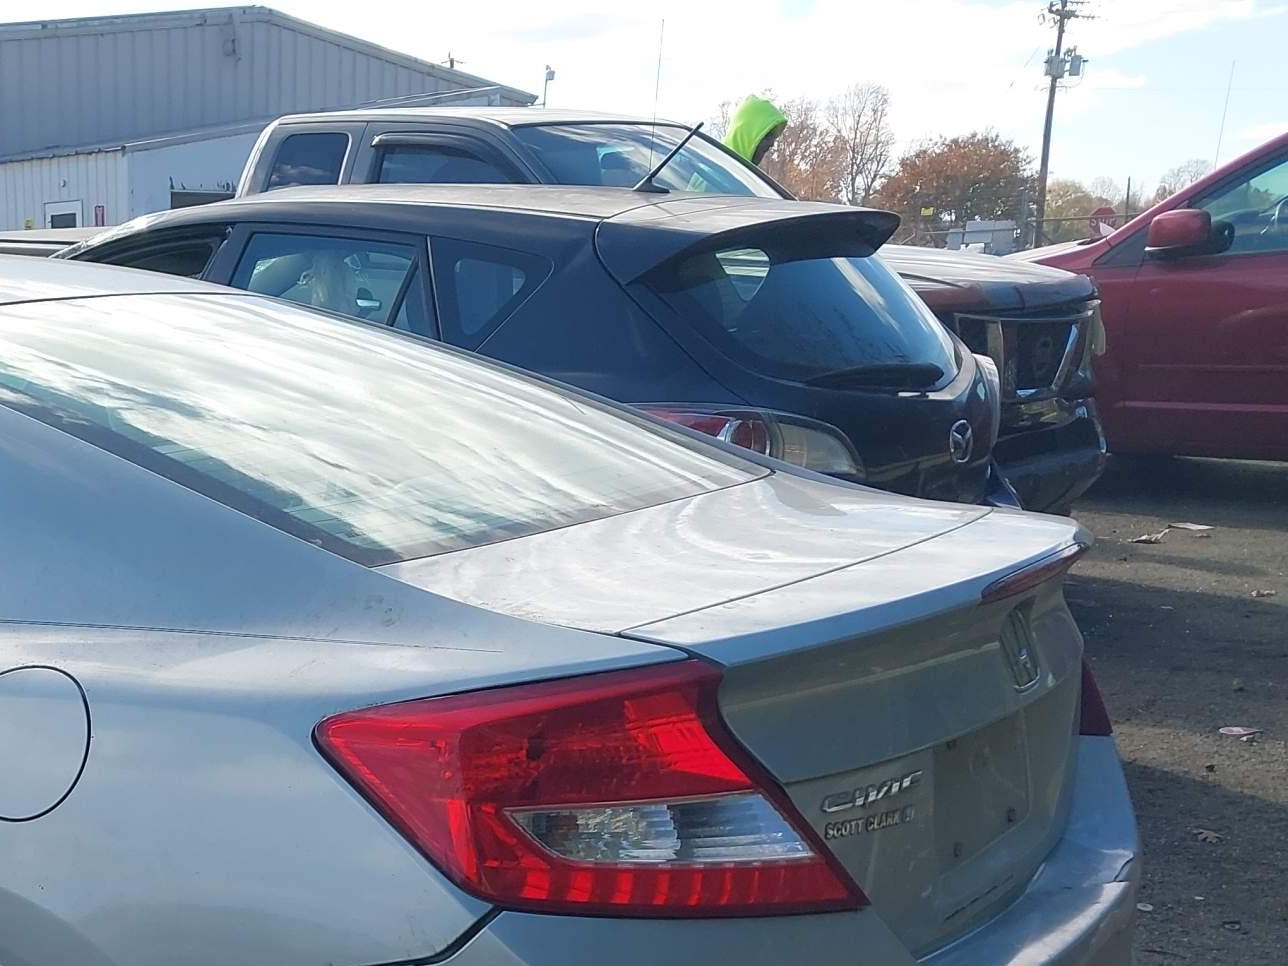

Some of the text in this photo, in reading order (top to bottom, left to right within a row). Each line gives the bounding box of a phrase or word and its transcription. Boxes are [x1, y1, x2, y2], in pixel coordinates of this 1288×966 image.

[821, 769, 923, 813] CIVIC
[824, 809, 901, 840] SCOTT CLARK
